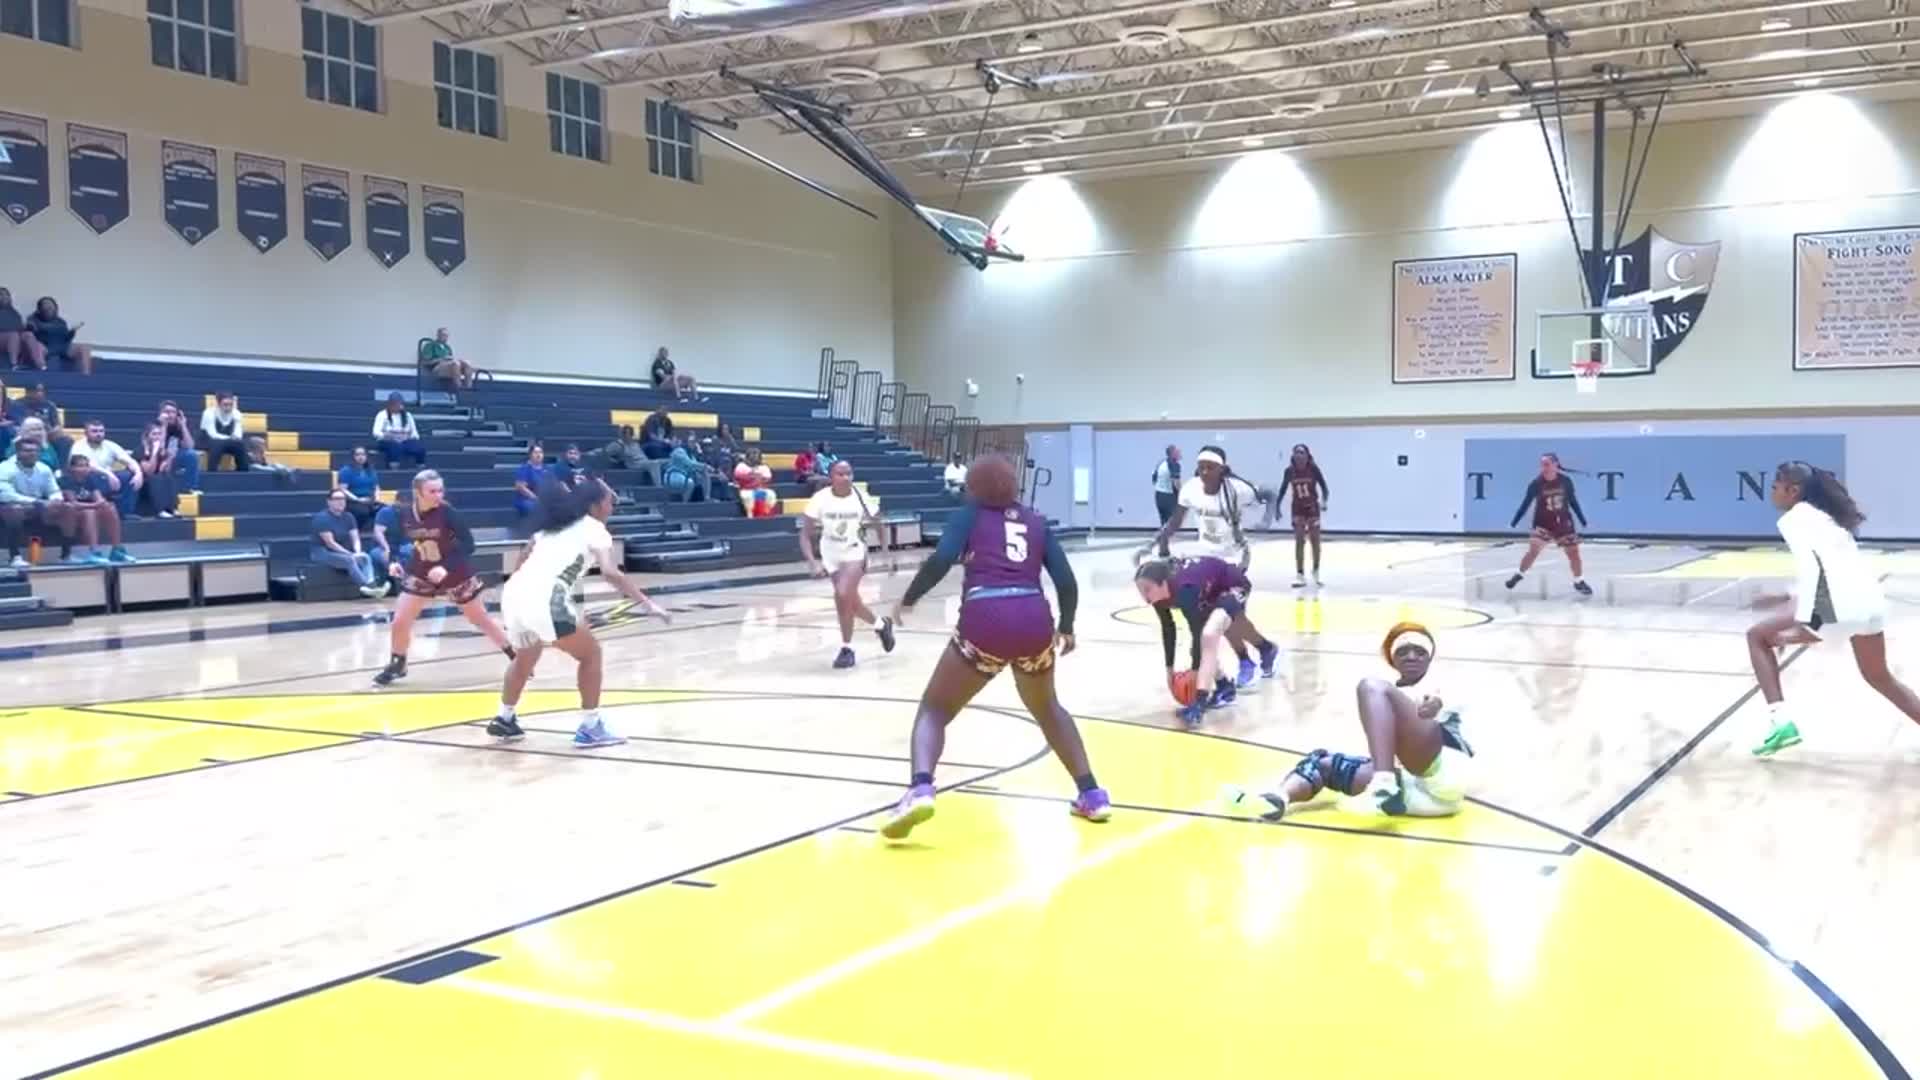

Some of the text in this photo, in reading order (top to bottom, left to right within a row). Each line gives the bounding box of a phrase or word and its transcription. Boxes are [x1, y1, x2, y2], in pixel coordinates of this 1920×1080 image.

[1827, 243, 1913, 259] FIGHT SONG
[1604, 249, 1697, 286] T C
[1416, 272, 1494, 286] ALMA MATER
[1296, 483, 1311, 499] 11
[1003, 521, 1029, 563] 5
